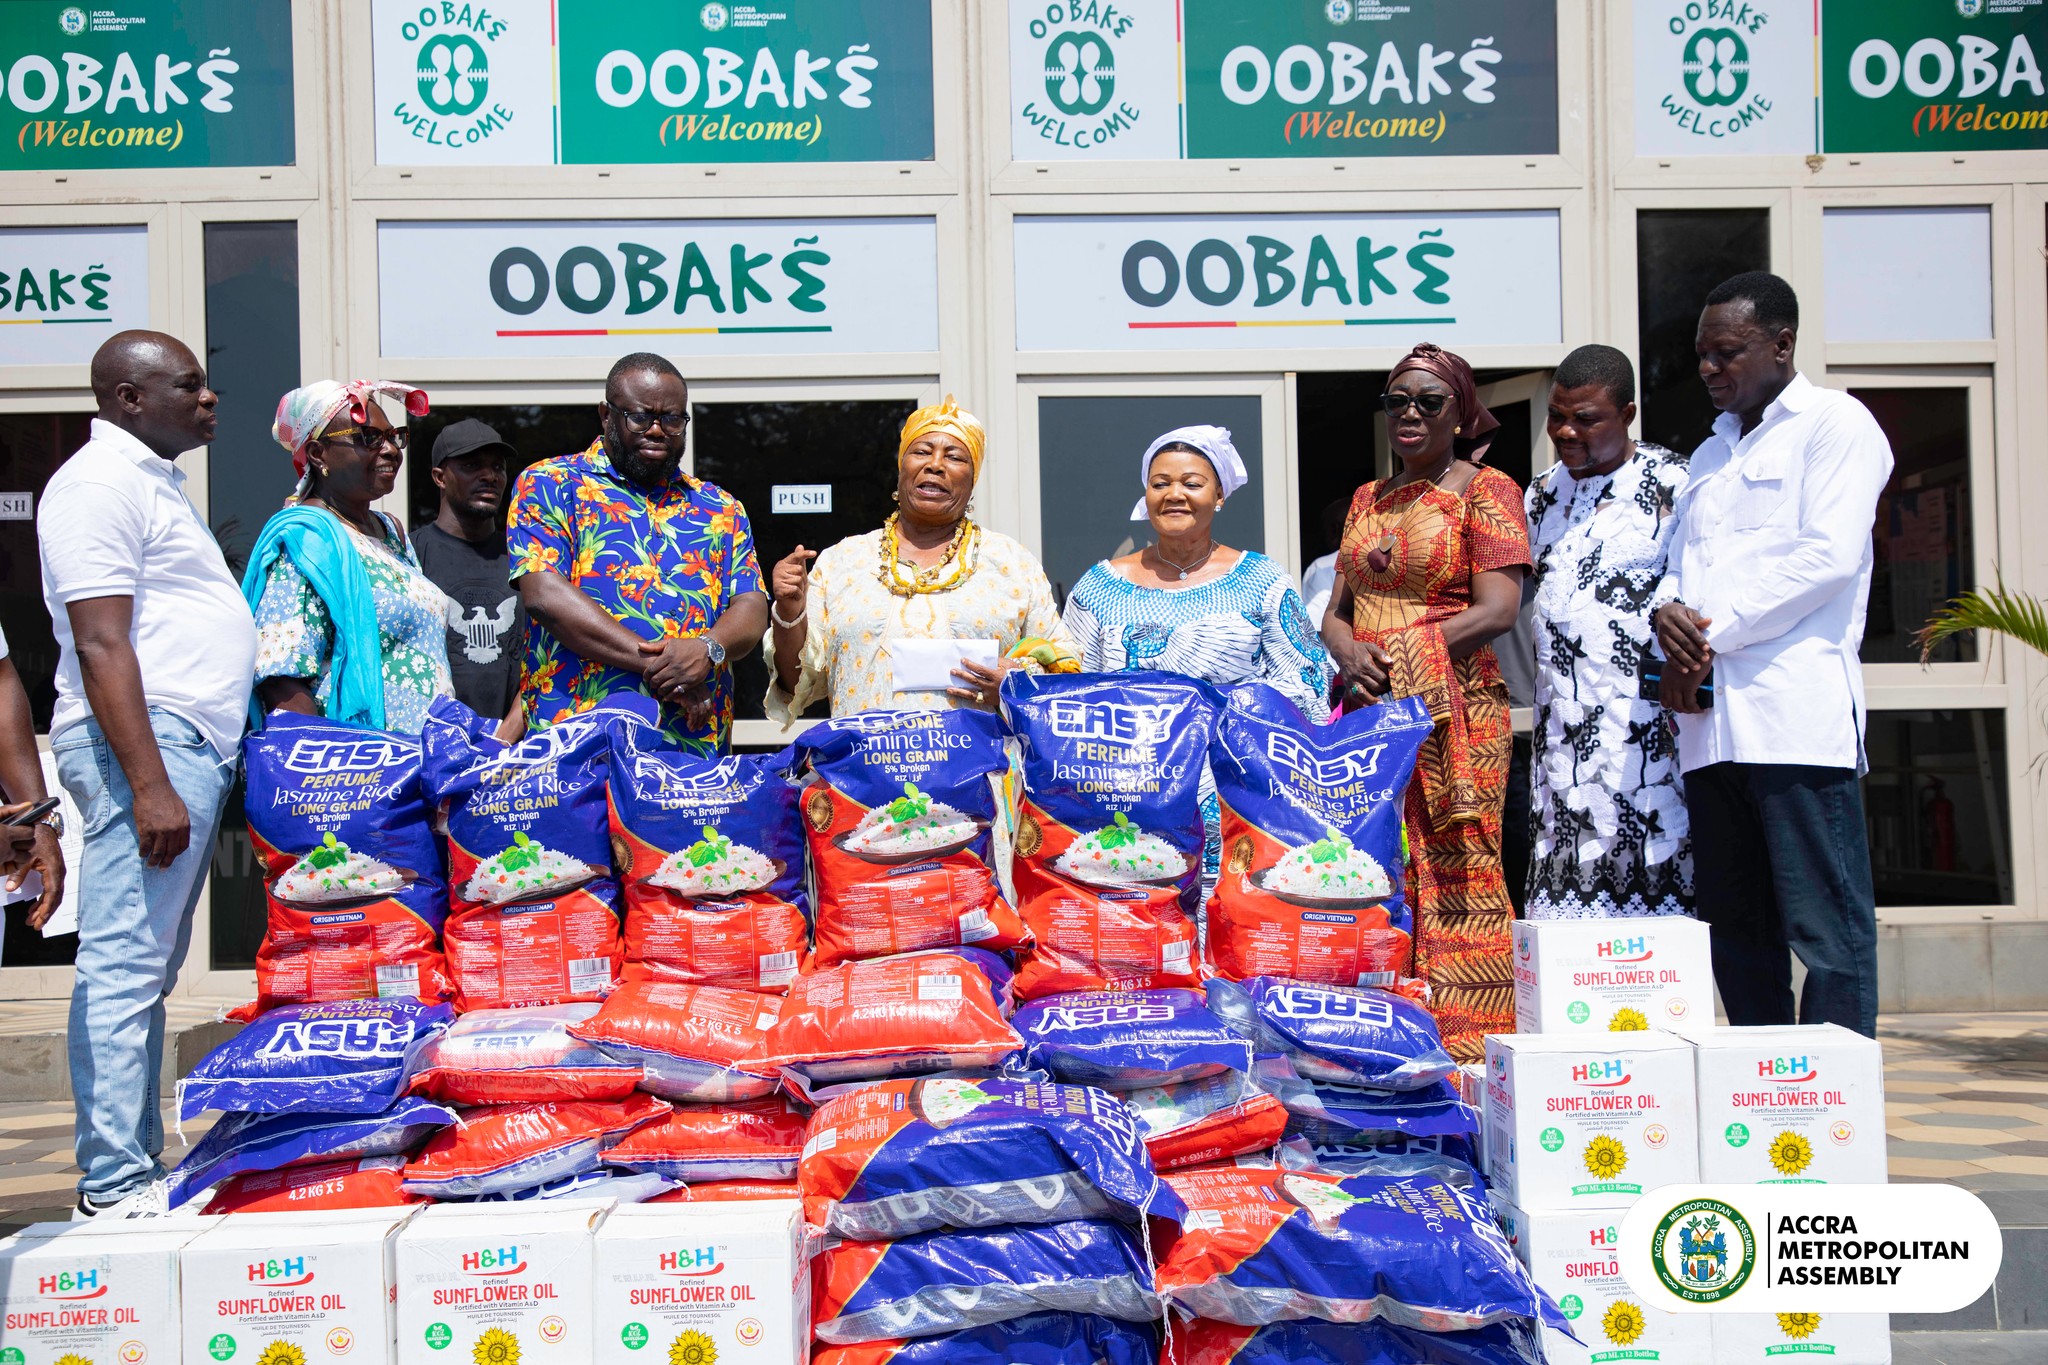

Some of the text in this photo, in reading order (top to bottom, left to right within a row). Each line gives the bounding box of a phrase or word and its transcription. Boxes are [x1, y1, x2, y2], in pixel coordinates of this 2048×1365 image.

[394, 102, 514, 148] WELCOME
[1022, 102, 1140, 148] WELCOME
[1661, 94, 1773, 137] WELCOME
[18, 119, 184, 152] (Welcome)
[660, 114, 822, 146] (Welcome)
[1284, 110, 1446, 144] (Welcome)
[779, 493, 824, 505] PUSH
[1051, 700, 1177, 745] EASY
[928, 729, 972, 749] Rice
[864, 750, 948, 765] LONG GRAIN
[1077, 742, 1157, 763] PERFUME
[1268, 732, 1387, 787] EASY
[885, 764, 930, 773] 5% Broken
[1051, 759, 1135, 782] Jasmine
[301, 770, 384, 788] PERFUME
[539, 774, 581, 794] Rice
[1077, 780, 1114, 793] LONG
[1290, 771, 1365, 800] PERFUME
[272, 786, 353, 808] Jasmine
[472, 795, 559, 817] LONG GRAIN
[1096, 793, 1141, 803] 5% Broken
[1349, 786, 1394, 808] Rice
[292, 800, 371, 816] LONG GRAIN
[308, 812, 351, 824] 5% Broken
[493, 811, 540, 824] 5% Broken
[683, 806, 730, 818] 5% Broken
[316, 823, 328, 832] RIZ
[504, 823, 517, 832] RIZ
[693, 818, 706, 826] RIZ
[336, 913, 362, 921] VIETNAM
[505, 903, 553, 914] ORIGIN VIETNAM
[1327, 914, 1354, 922] VIETNAM
[1121, 980, 1134, 990] KG
[1145, 978, 1151, 987] 5
[1573, 969, 1681, 986] SUNFLOWER OIL
[1265, 985, 1393, 1028] EASY
[690, 1017, 732, 1033] 4.2 KG X
[1036, 1005, 1174, 1034] EASY
[1572, 1059, 1622, 1081] H&H
[1758, 1056, 1808, 1077] H&H
[1547, 1095, 1660, 1112] SUNFLOWER OIL
[1732, 1091, 1846, 1107] SUNFLOWER OIL
[721, 1114, 738, 1124] 4.2
[740, 1114, 754, 1124] KG
[289, 1182, 344, 1201] 4.2 KG X 5
[462, 1245, 518, 1271] H&H
[659, 1246, 715, 1271] H&H
[247, 1256, 304, 1281] H&H
[39, 1269, 97, 1294] H&H
[433, 1284, 558, 1305] SUNFLOWER OIL
[630, 1285, 755, 1305] SUNFLOWER OIL
[218, 1294, 346, 1316] SUNFLOWER OIL
[6, 1307, 140, 1329] SUNFLOWER OIL
